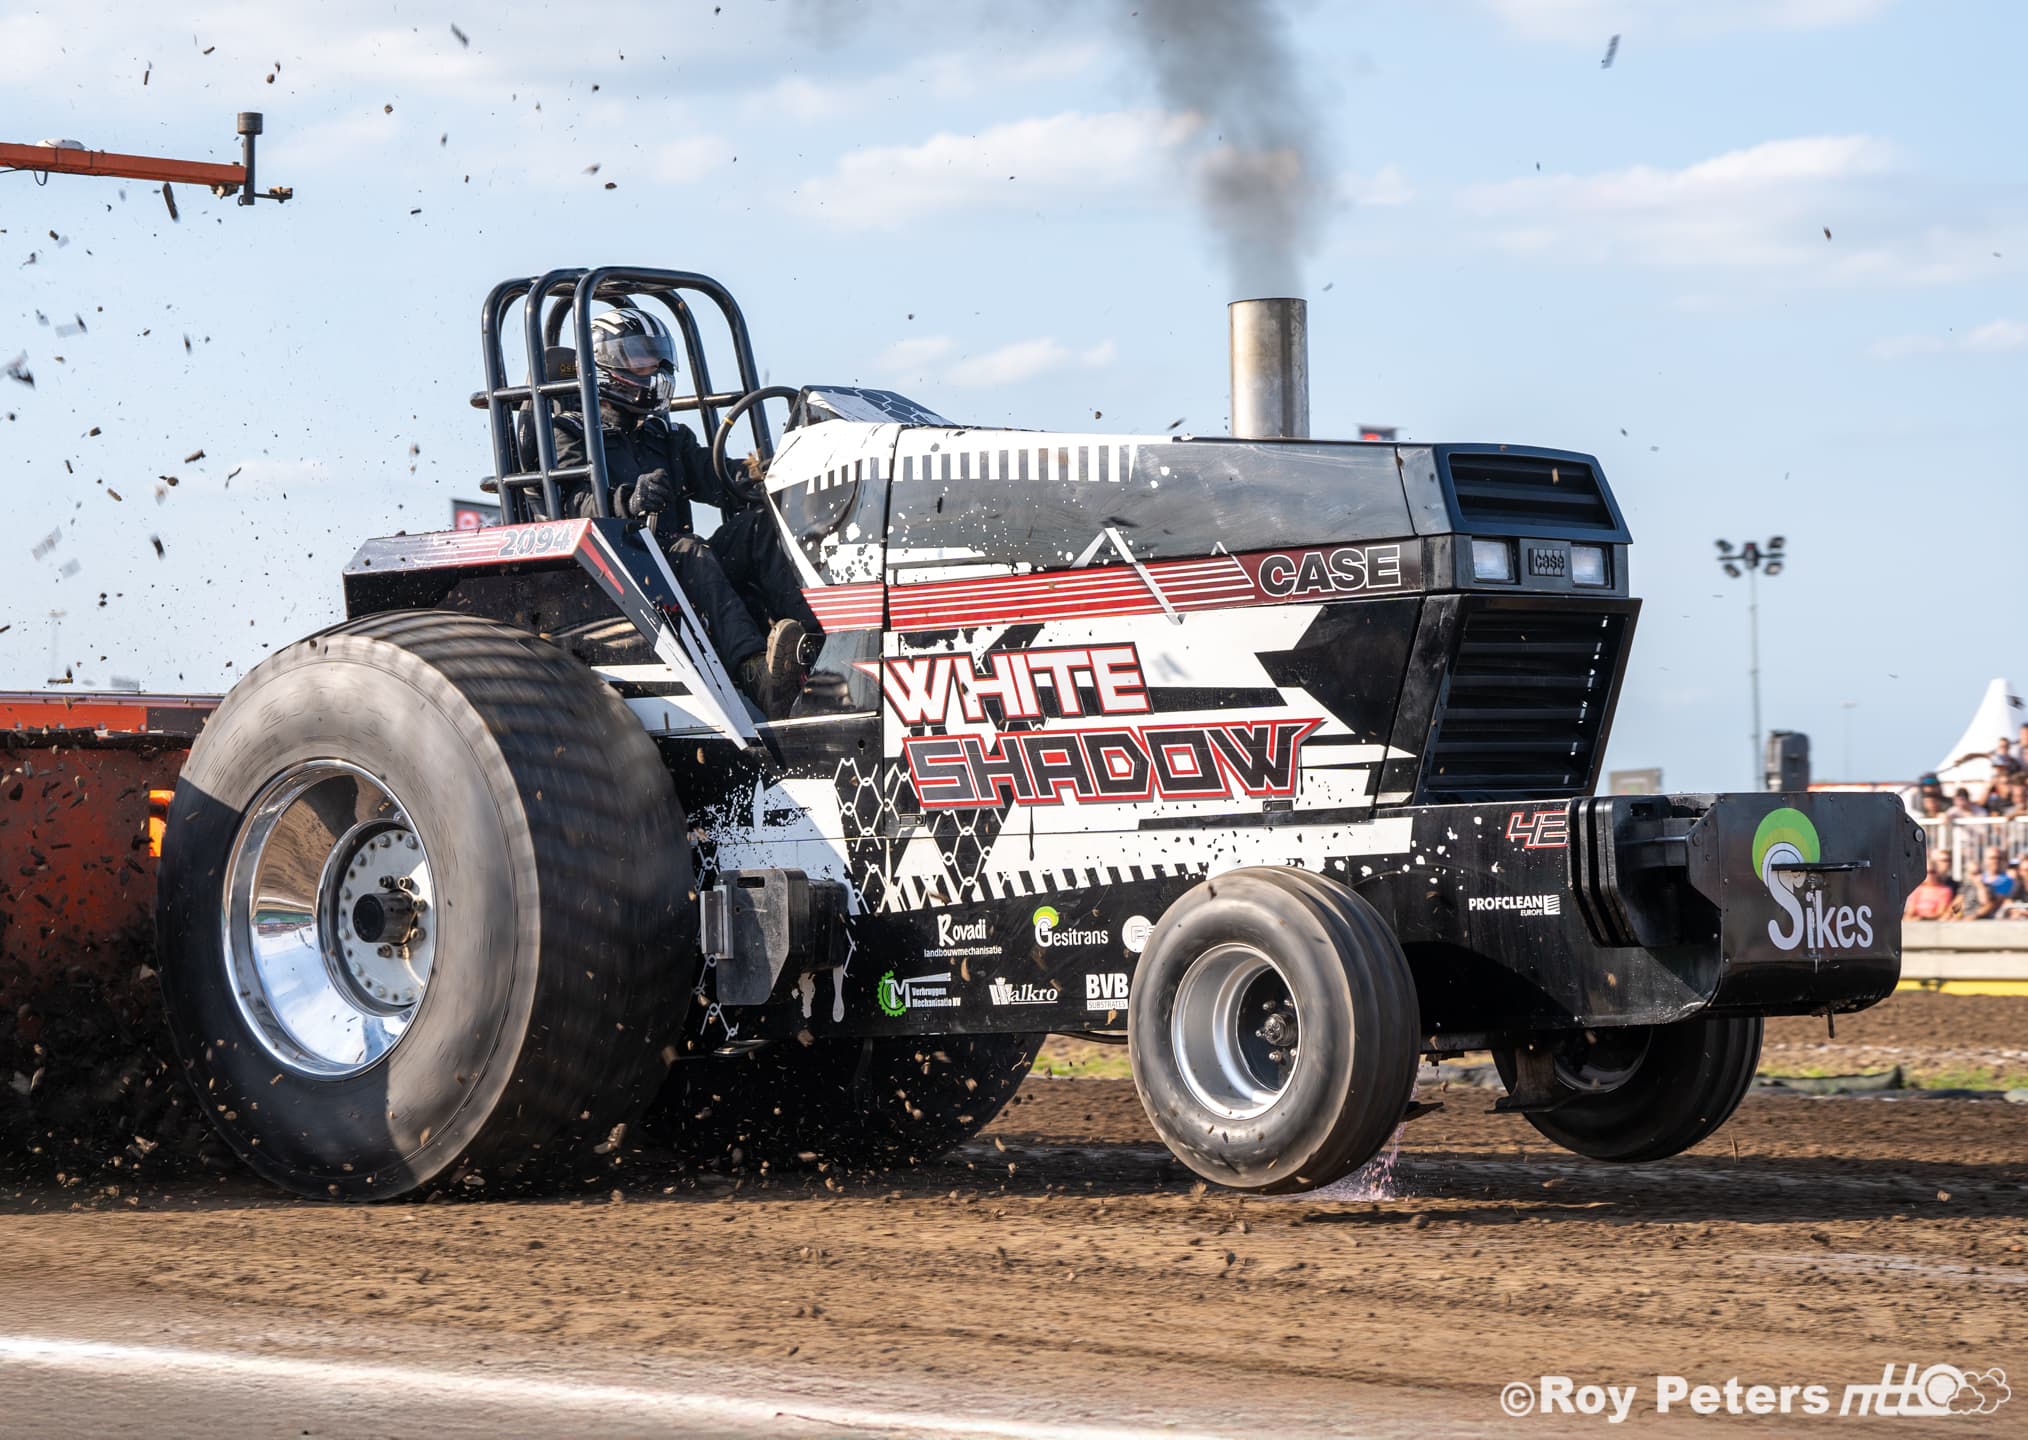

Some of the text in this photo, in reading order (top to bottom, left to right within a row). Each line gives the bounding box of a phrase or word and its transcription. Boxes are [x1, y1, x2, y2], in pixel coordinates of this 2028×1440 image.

[499, 526, 572, 557] 2094
[1258, 543, 1402, 597] CASE
[882, 642, 1154, 724] WHITE
[902, 717, 1325, 808] SHADOW
[1468, 895, 1543, 911] PROFCLEAN
[1762, 842, 1874, 951] Sikes
[937, 913, 987, 947] Rovadi
[1034, 916, 1109, 947] Gesitrans
[923, 945, 1002, 958] landbouwmechanisatie
[989, 977, 1058, 1005] Walkro
[1085, 973, 1129, 999] BVB
[1088, 1000, 1126, 1009] SUBSTRATES
